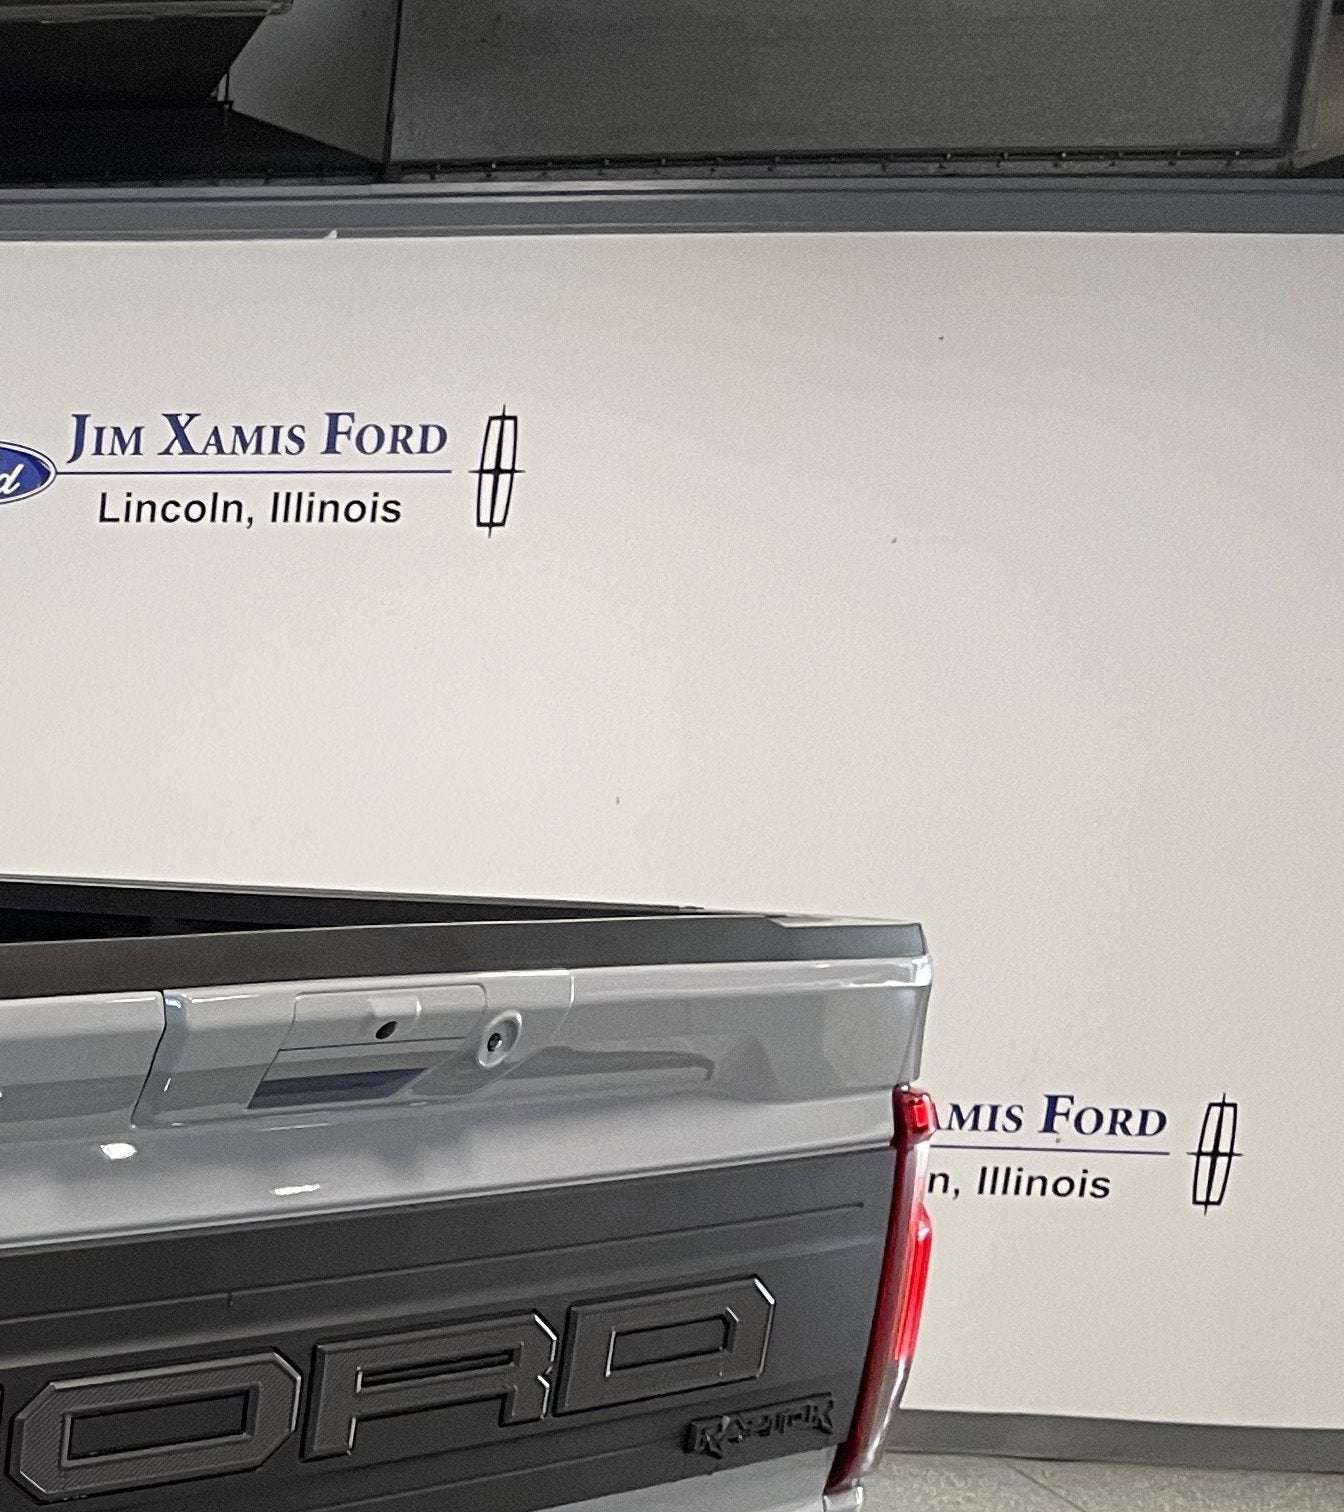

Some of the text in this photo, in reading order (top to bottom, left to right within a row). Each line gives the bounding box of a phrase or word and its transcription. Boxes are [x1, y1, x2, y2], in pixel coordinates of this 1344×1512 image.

[65, 411, 448, 465] JIM XAMIS FORD
[98, 492, 402, 530] Lincoln, Illinois
[1037, 1094, 1167, 1137] FORD
[977, 1166, 1111, 1199] Illinois
